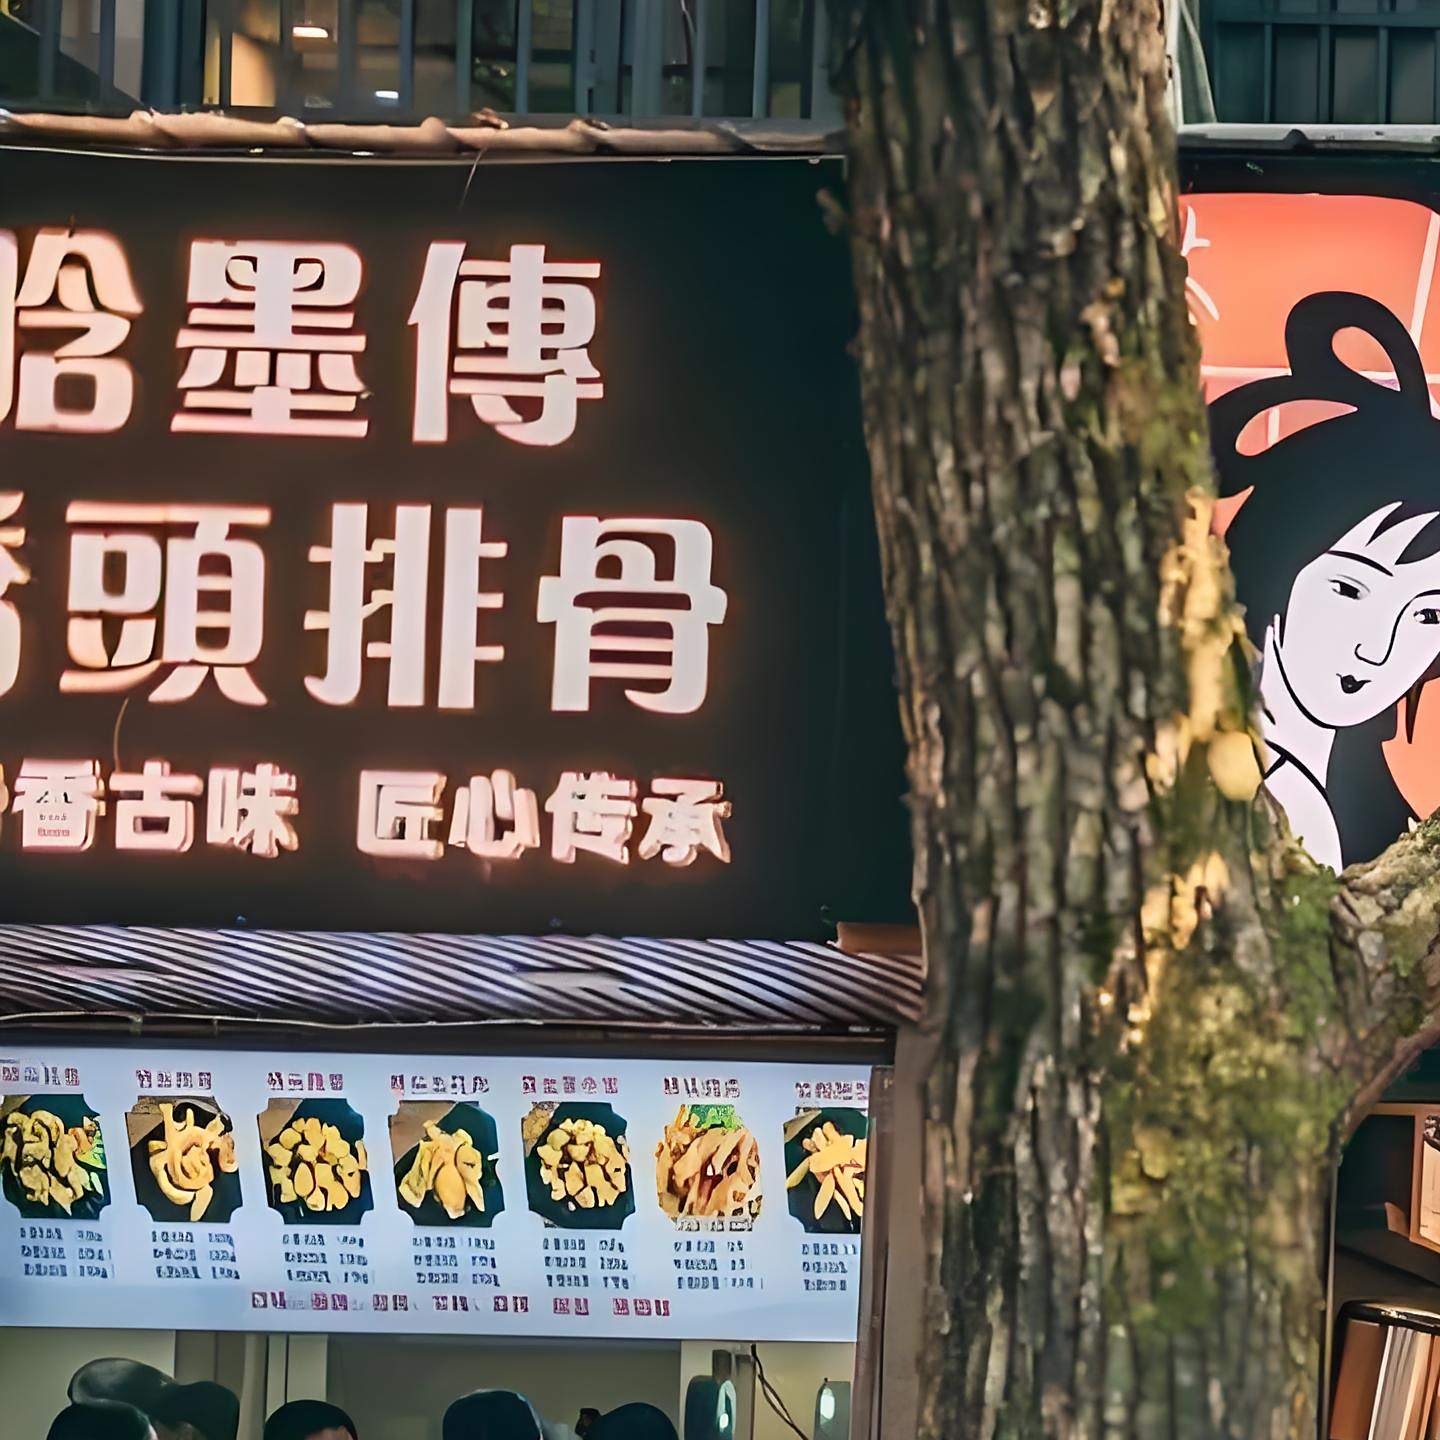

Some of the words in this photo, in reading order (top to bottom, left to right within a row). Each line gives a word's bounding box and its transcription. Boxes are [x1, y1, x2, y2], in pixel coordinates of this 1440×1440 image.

[0, 758, 300, 859] 香古味
[356, 768, 732, 867] 匠心传承
